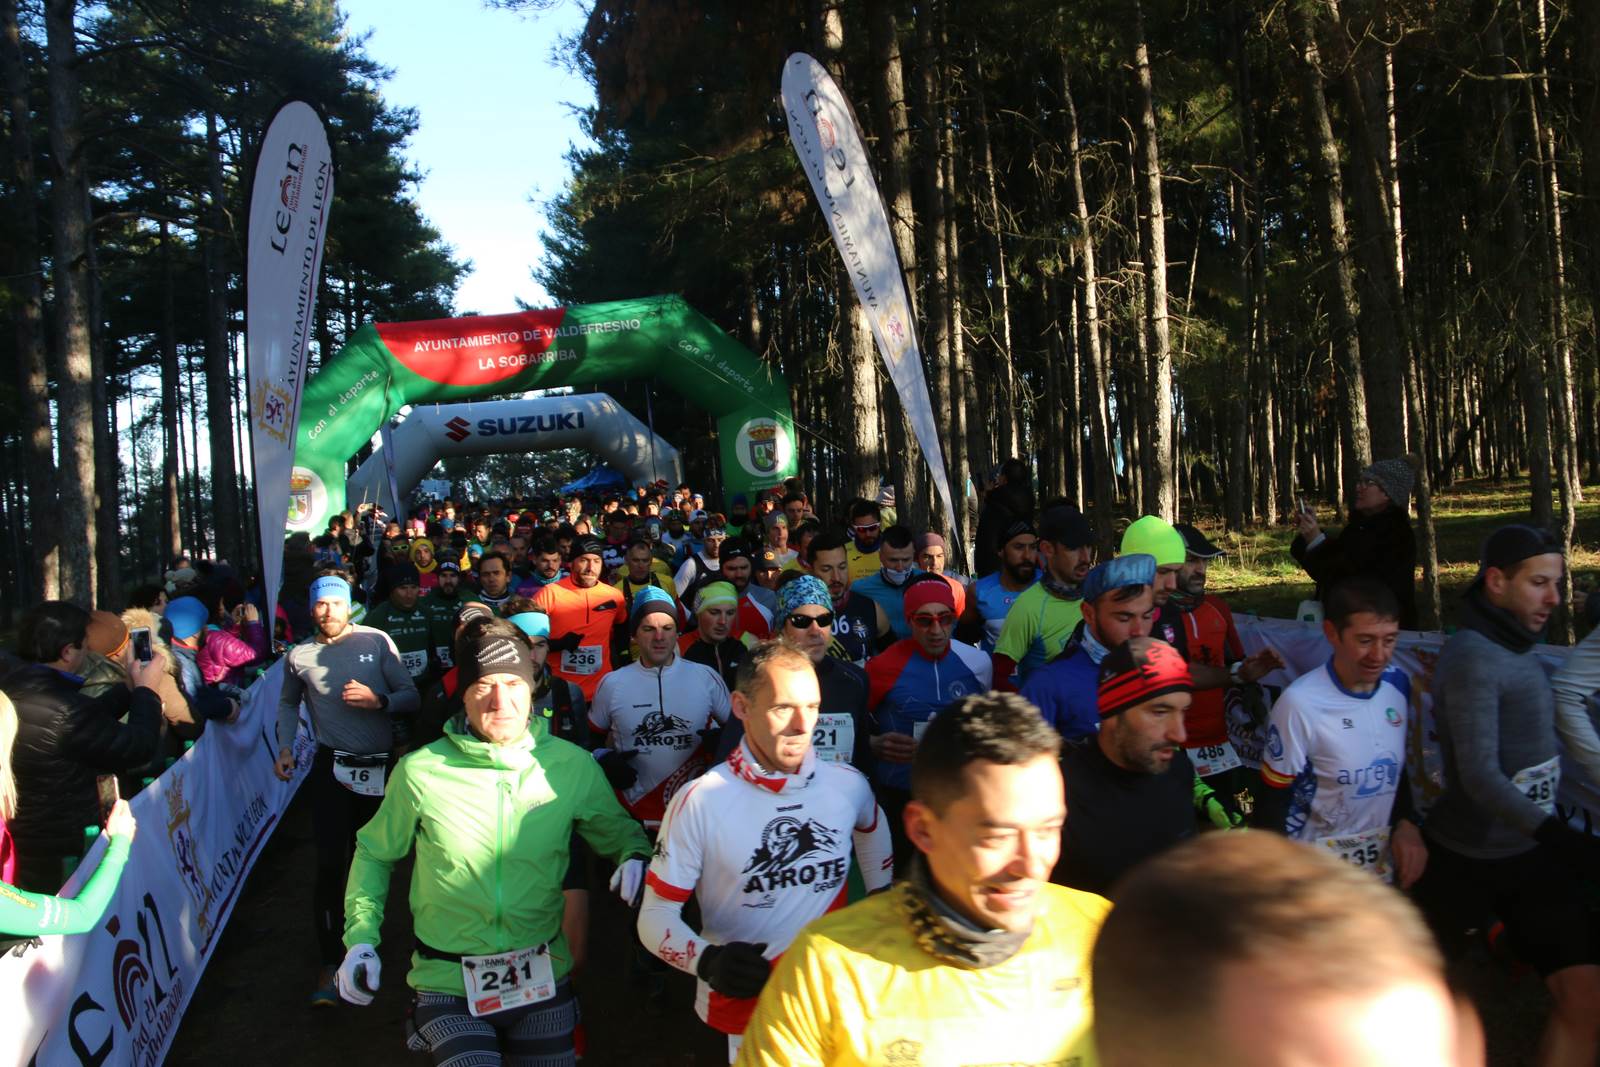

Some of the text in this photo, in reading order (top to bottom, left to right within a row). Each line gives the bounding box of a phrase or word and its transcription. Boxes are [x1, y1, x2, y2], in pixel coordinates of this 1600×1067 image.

[287, 160, 328, 389] AYUNTAMIENTO DE LEÓN
[414, 318, 641, 353] AYUNTAMIENTO DE VALDEFRESNO
[478, 349, 577, 370] LA SOBARRIBA
[677, 339, 755, 393] Con el deporte
[308, 370, 380, 440] Con el deporte
[477, 411, 585, 437] SUZUKI
[568, 654, 596, 665] 236
[632, 734, 694, 748] ATROTE
[349, 769, 370, 783] 16
[743, 856, 847, 894] ATROTE
[481, 961, 533, 992] 241
